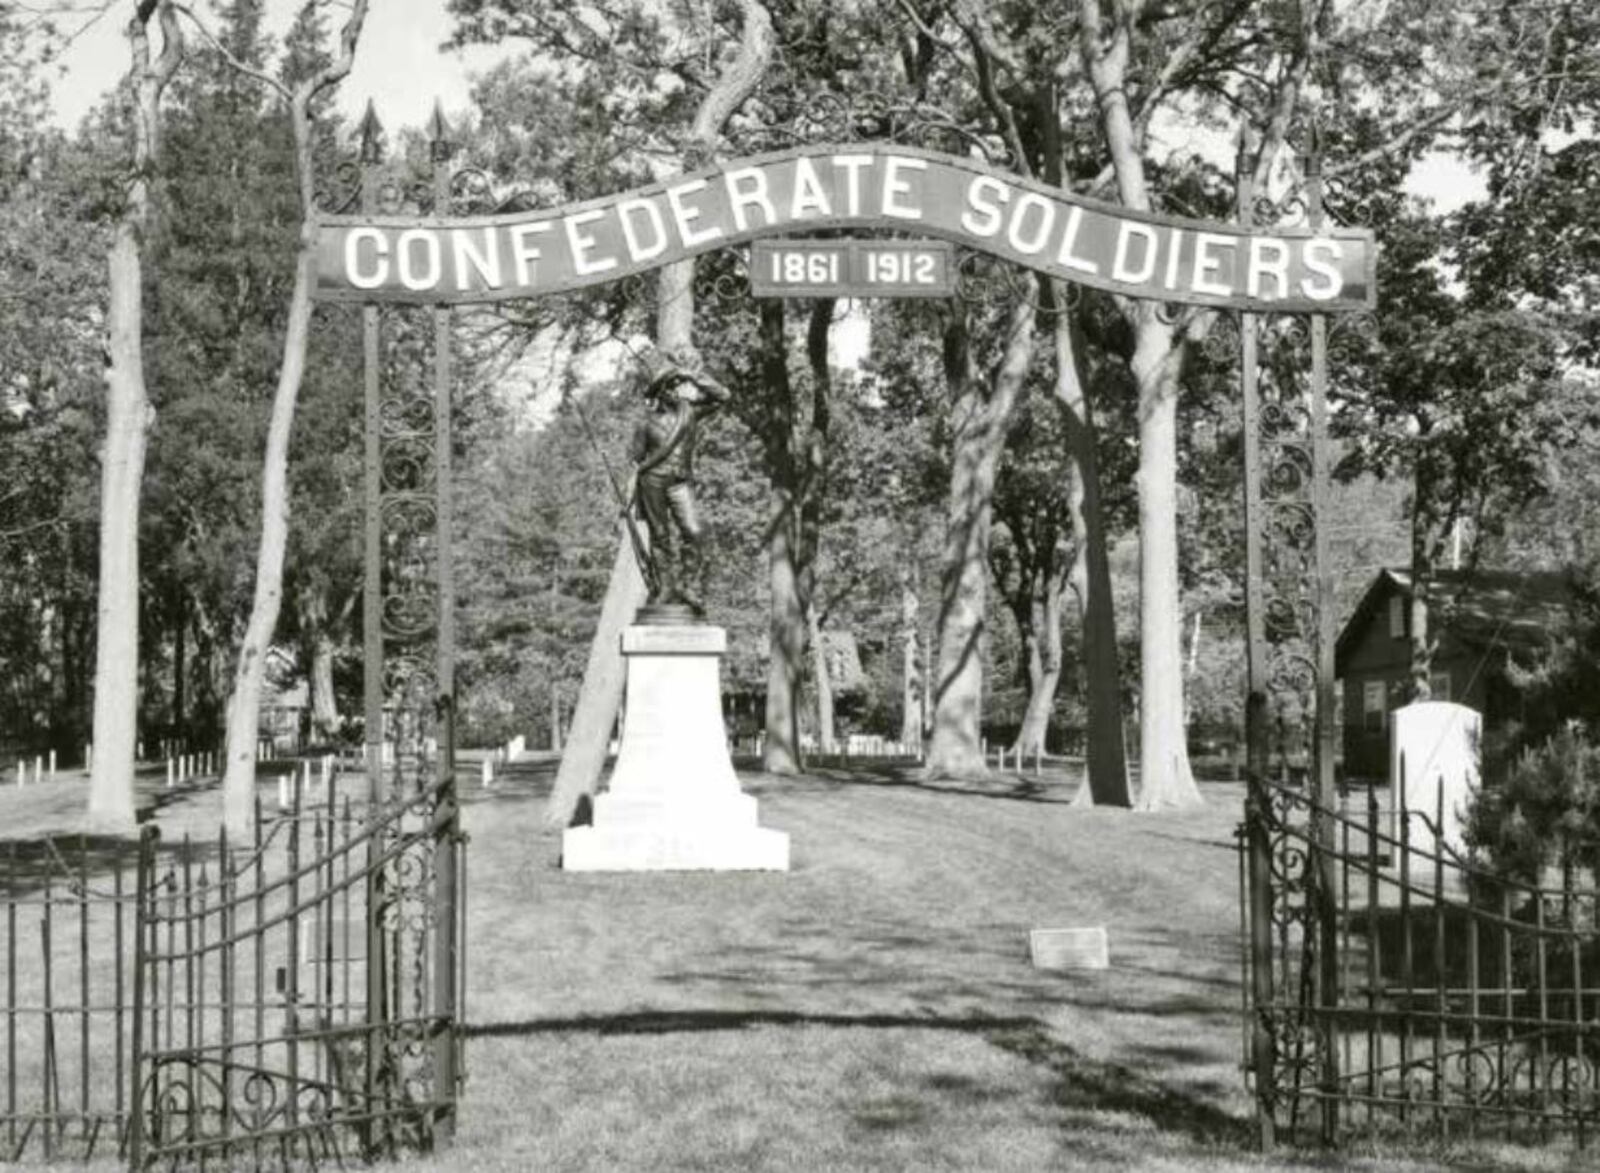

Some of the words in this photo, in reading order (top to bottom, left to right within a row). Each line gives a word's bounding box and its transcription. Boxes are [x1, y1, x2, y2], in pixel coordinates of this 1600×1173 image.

[345, 156, 928, 291] CONFEDERATE
[962, 176, 1343, 300] SOLDIERS
[771, 253, 838, 284] 1861
[867, 253, 936, 284] 1912
